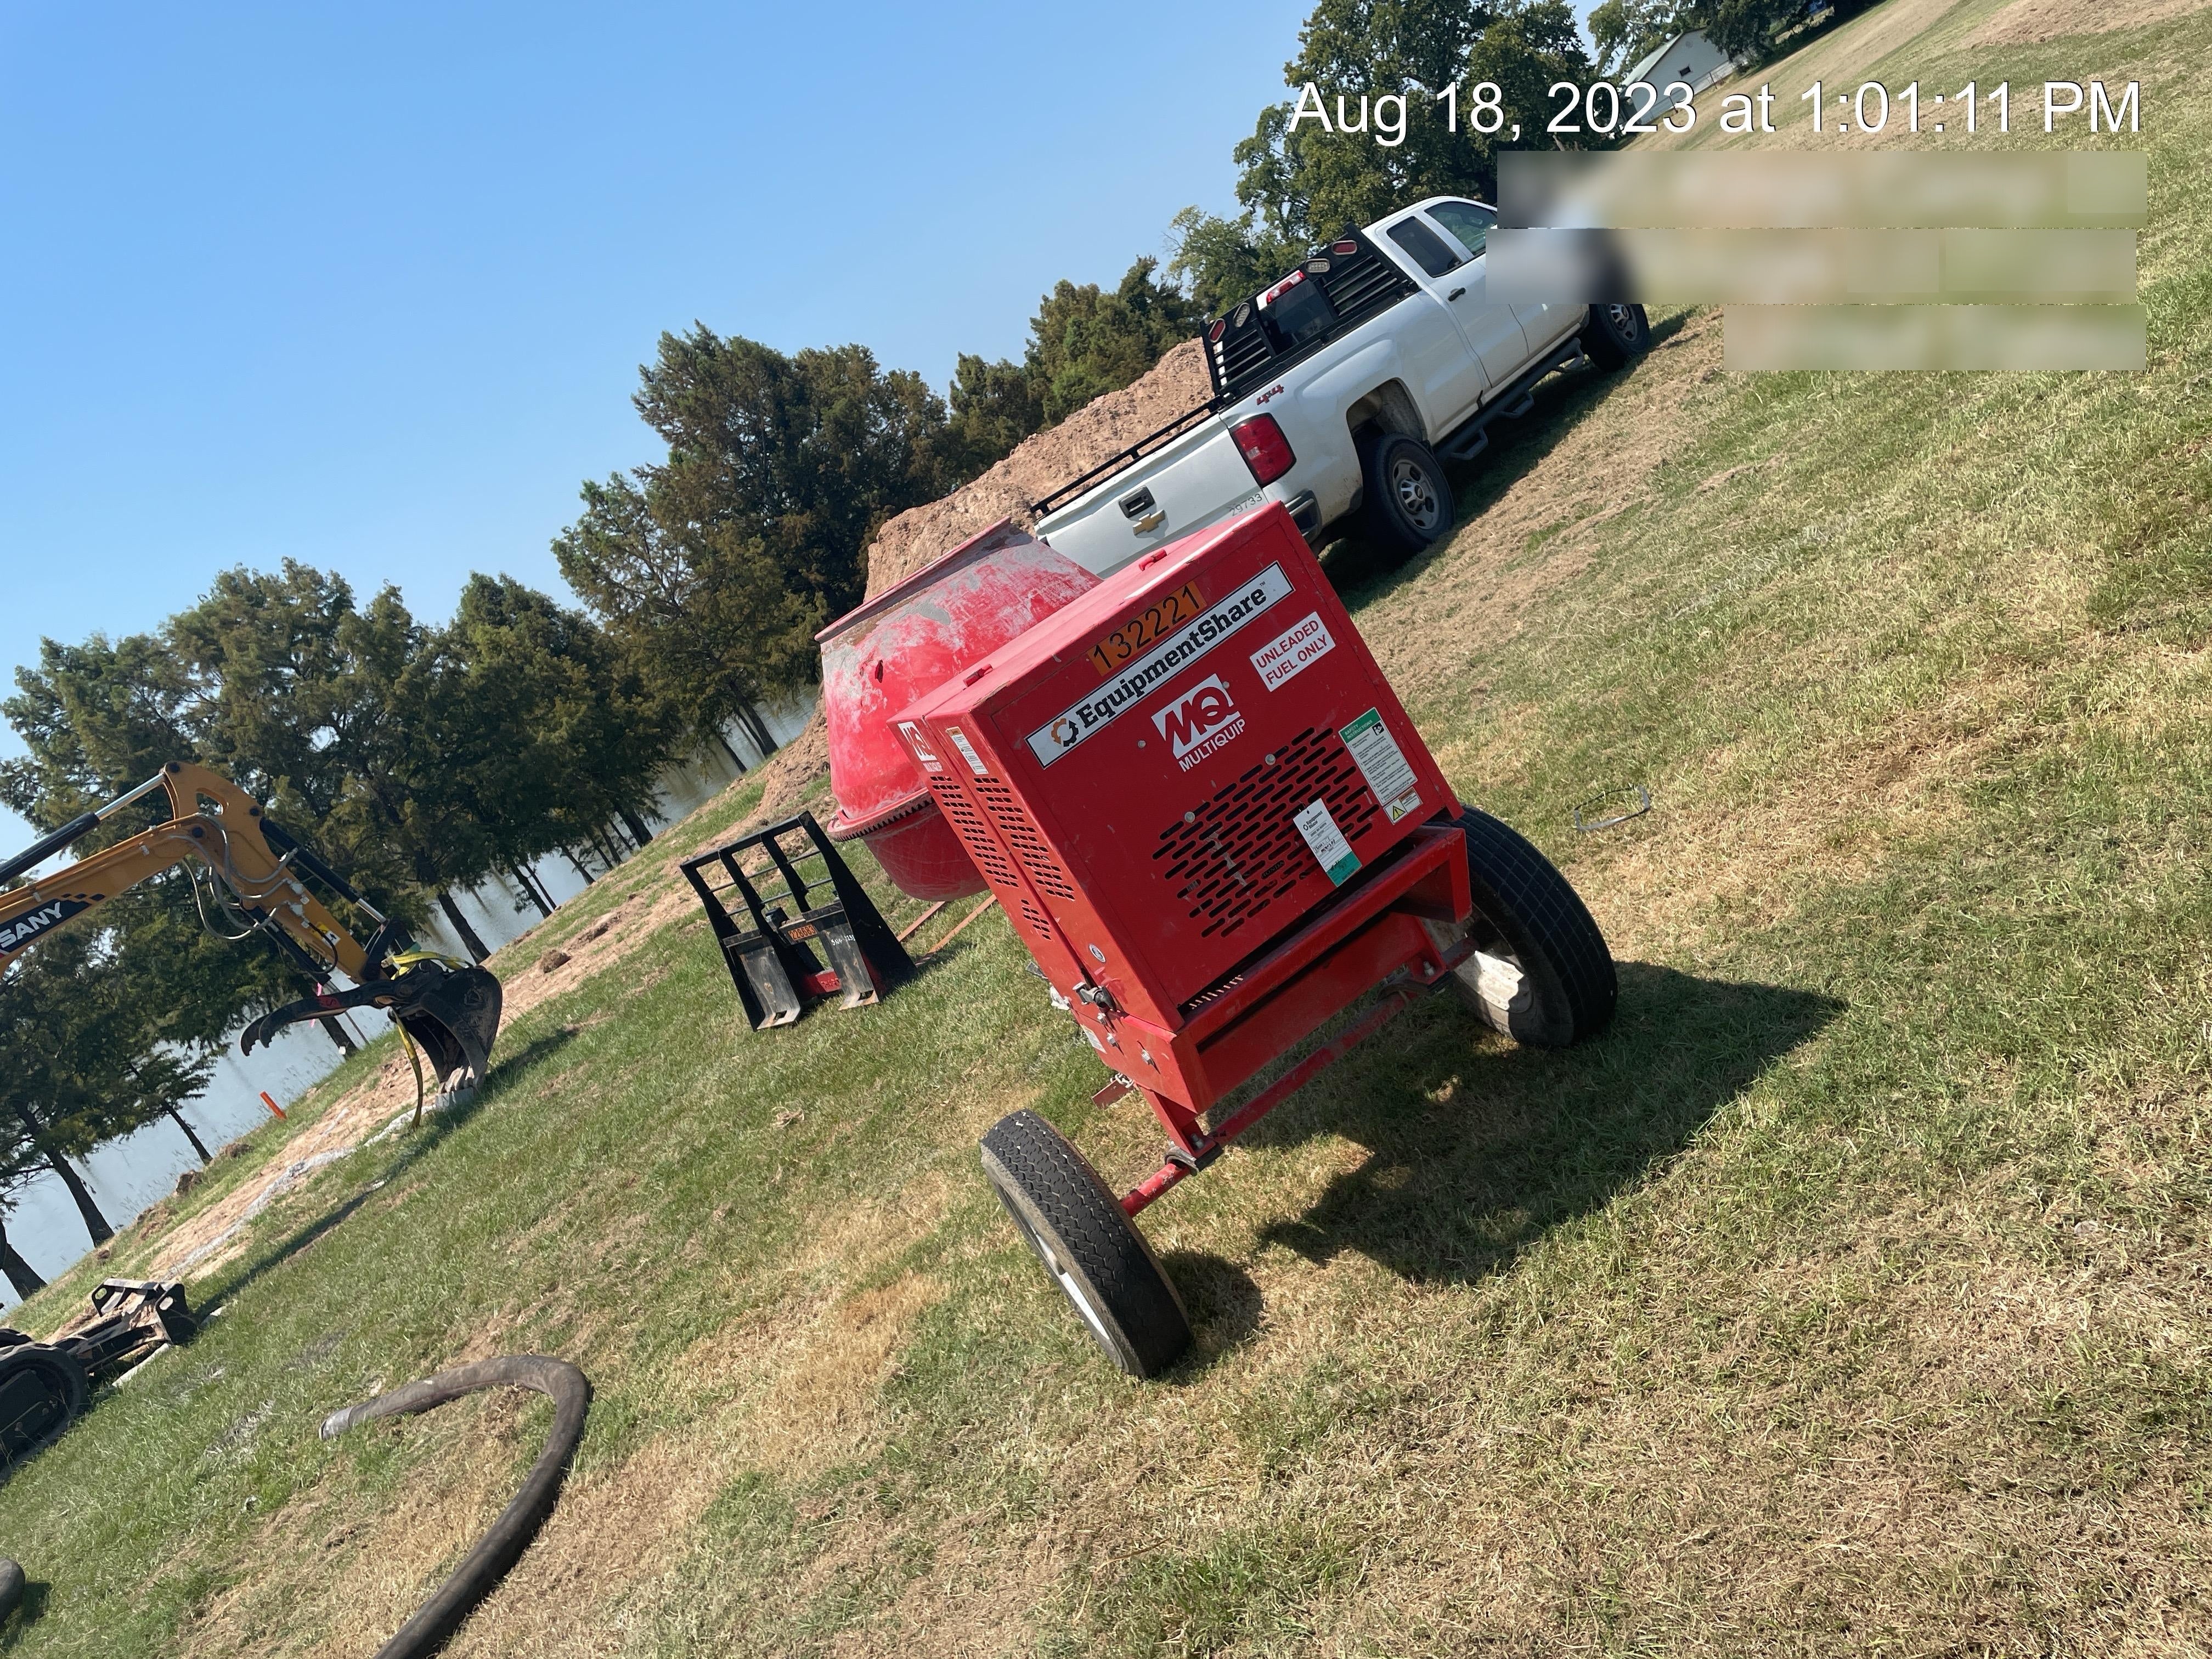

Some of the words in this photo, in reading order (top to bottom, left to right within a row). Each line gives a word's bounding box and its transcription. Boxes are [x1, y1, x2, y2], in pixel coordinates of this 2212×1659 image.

[1229, 493, 1262, 516] 29733
[1094, 585, 1200, 669] 132221
[1256, 620, 1319, 668] UNLEADED
[1266, 659, 1298, 685] FUEL
[1297, 634, 1327, 662] ONLY
[1158, 679, 1239, 757] MQ
[1178, 719, 1245, 772] MULTIQUIP
[0, 901, 62, 948] SANY
[790, 925, 816, 939] 228683
